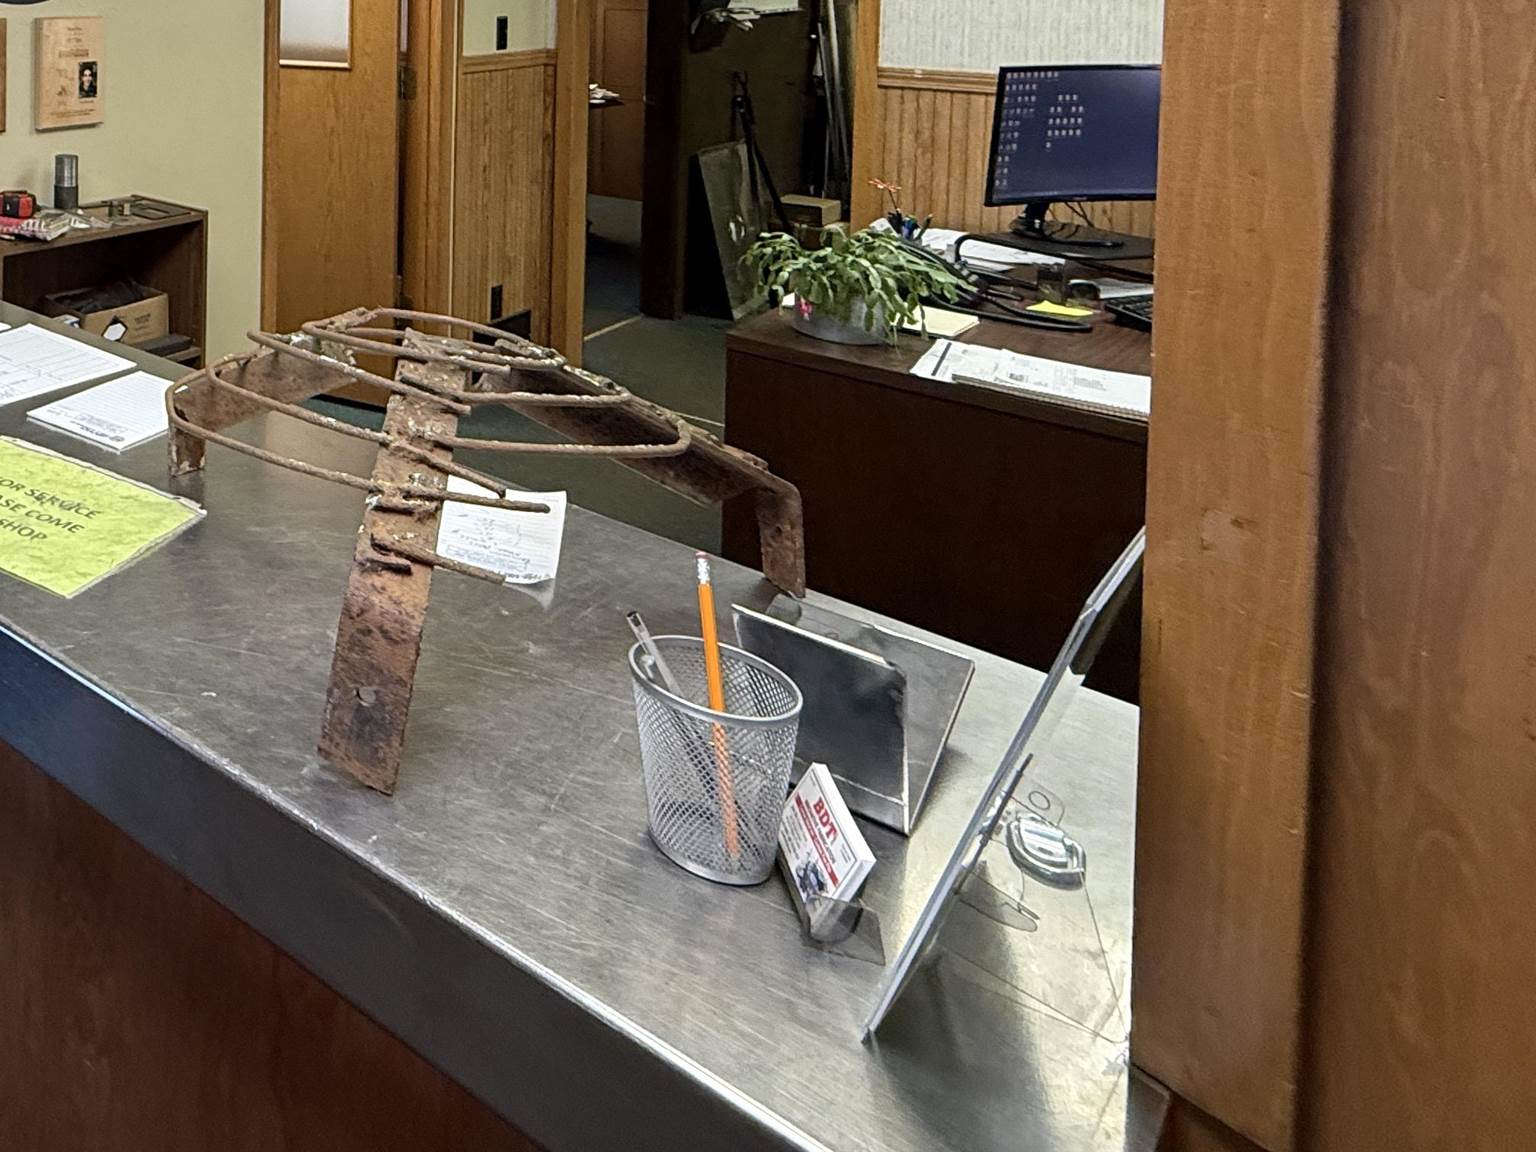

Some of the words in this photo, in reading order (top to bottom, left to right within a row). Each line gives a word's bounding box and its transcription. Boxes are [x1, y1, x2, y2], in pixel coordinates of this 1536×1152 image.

[24, 488, 102, 519] SERVICE
[25, 509, 85, 533] COME
[813, 797, 838, 839] BDT
